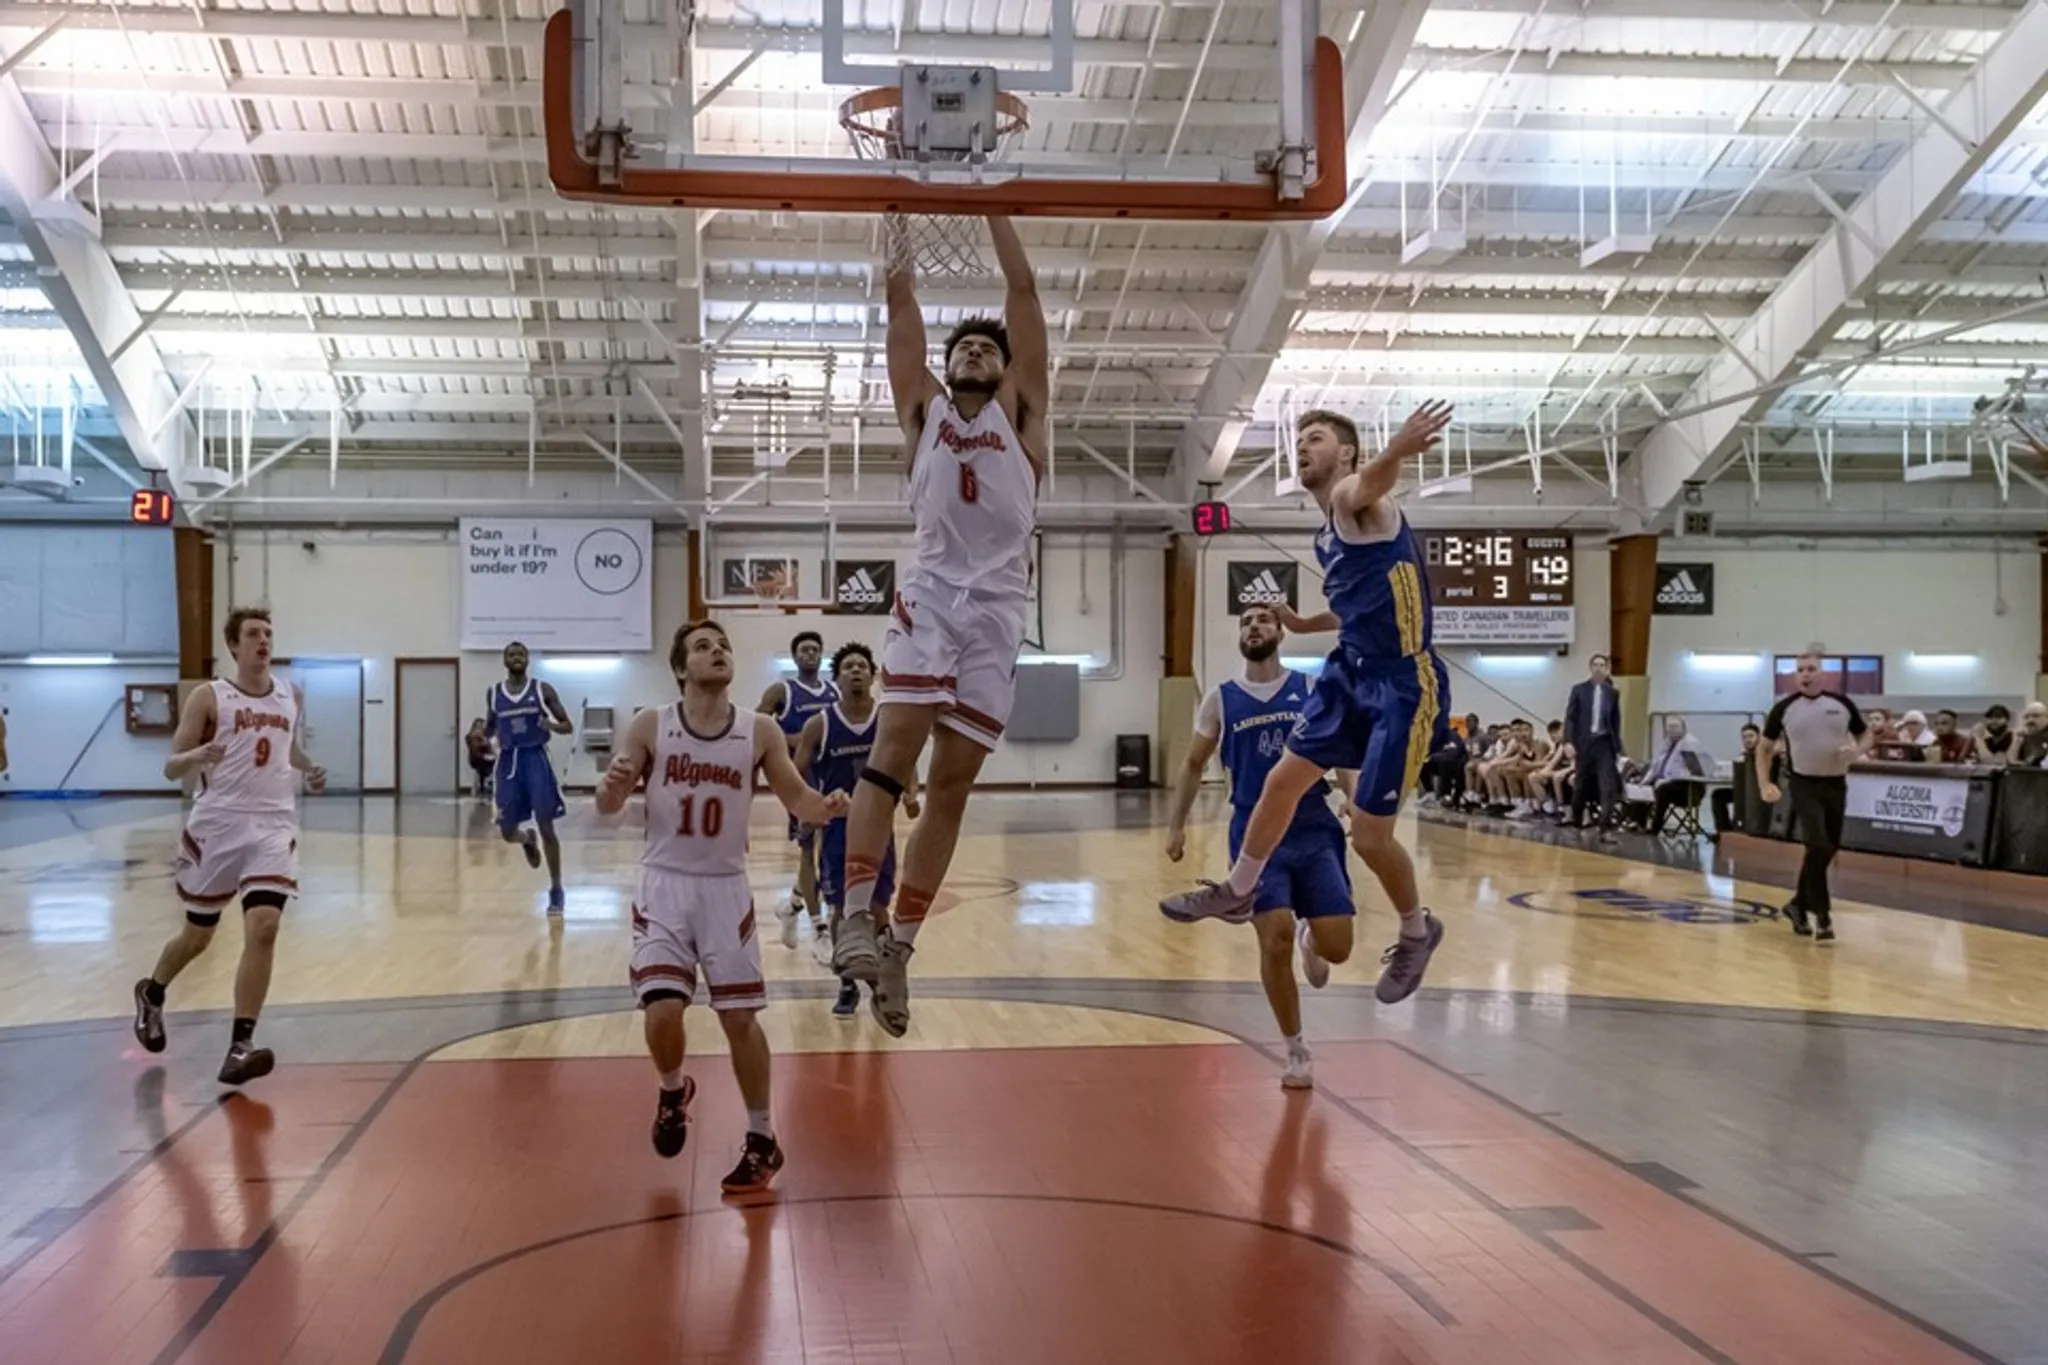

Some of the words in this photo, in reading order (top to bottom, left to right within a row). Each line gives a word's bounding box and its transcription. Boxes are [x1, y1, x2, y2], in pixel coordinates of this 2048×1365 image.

[134, 492, 169, 520] 21
[1197, 504, 1228, 532] 21
[469, 526, 503, 541] Can
[469, 544, 500, 559] buy
[503, 544, 515, 557] it
[518, 544, 530, 557] if
[532, 544, 558, 557] I'm
[595, 554, 624, 569] NO
[1444, 536, 1513, 566] 2:46
[469, 560, 517, 574] under
[521, 560, 548, 574] 19?
[1531, 555, 1569, 585] 49
[1237, 590, 1288, 605] adidas
[1493, 575, 1508, 599] 3
[1656, 590, 1706, 604] adidas
[1462, 609, 1509, 622] CANADIAN
[1512, 610, 1570, 622] TRAVELLERS
[256, 736, 271, 767] 9
[663, 752, 743, 792] Algoma
[1885, 784, 1932, 802] ALGOMA
[675, 794, 724, 837] 10
[1874, 799, 1939, 820] UNIVERSITY
